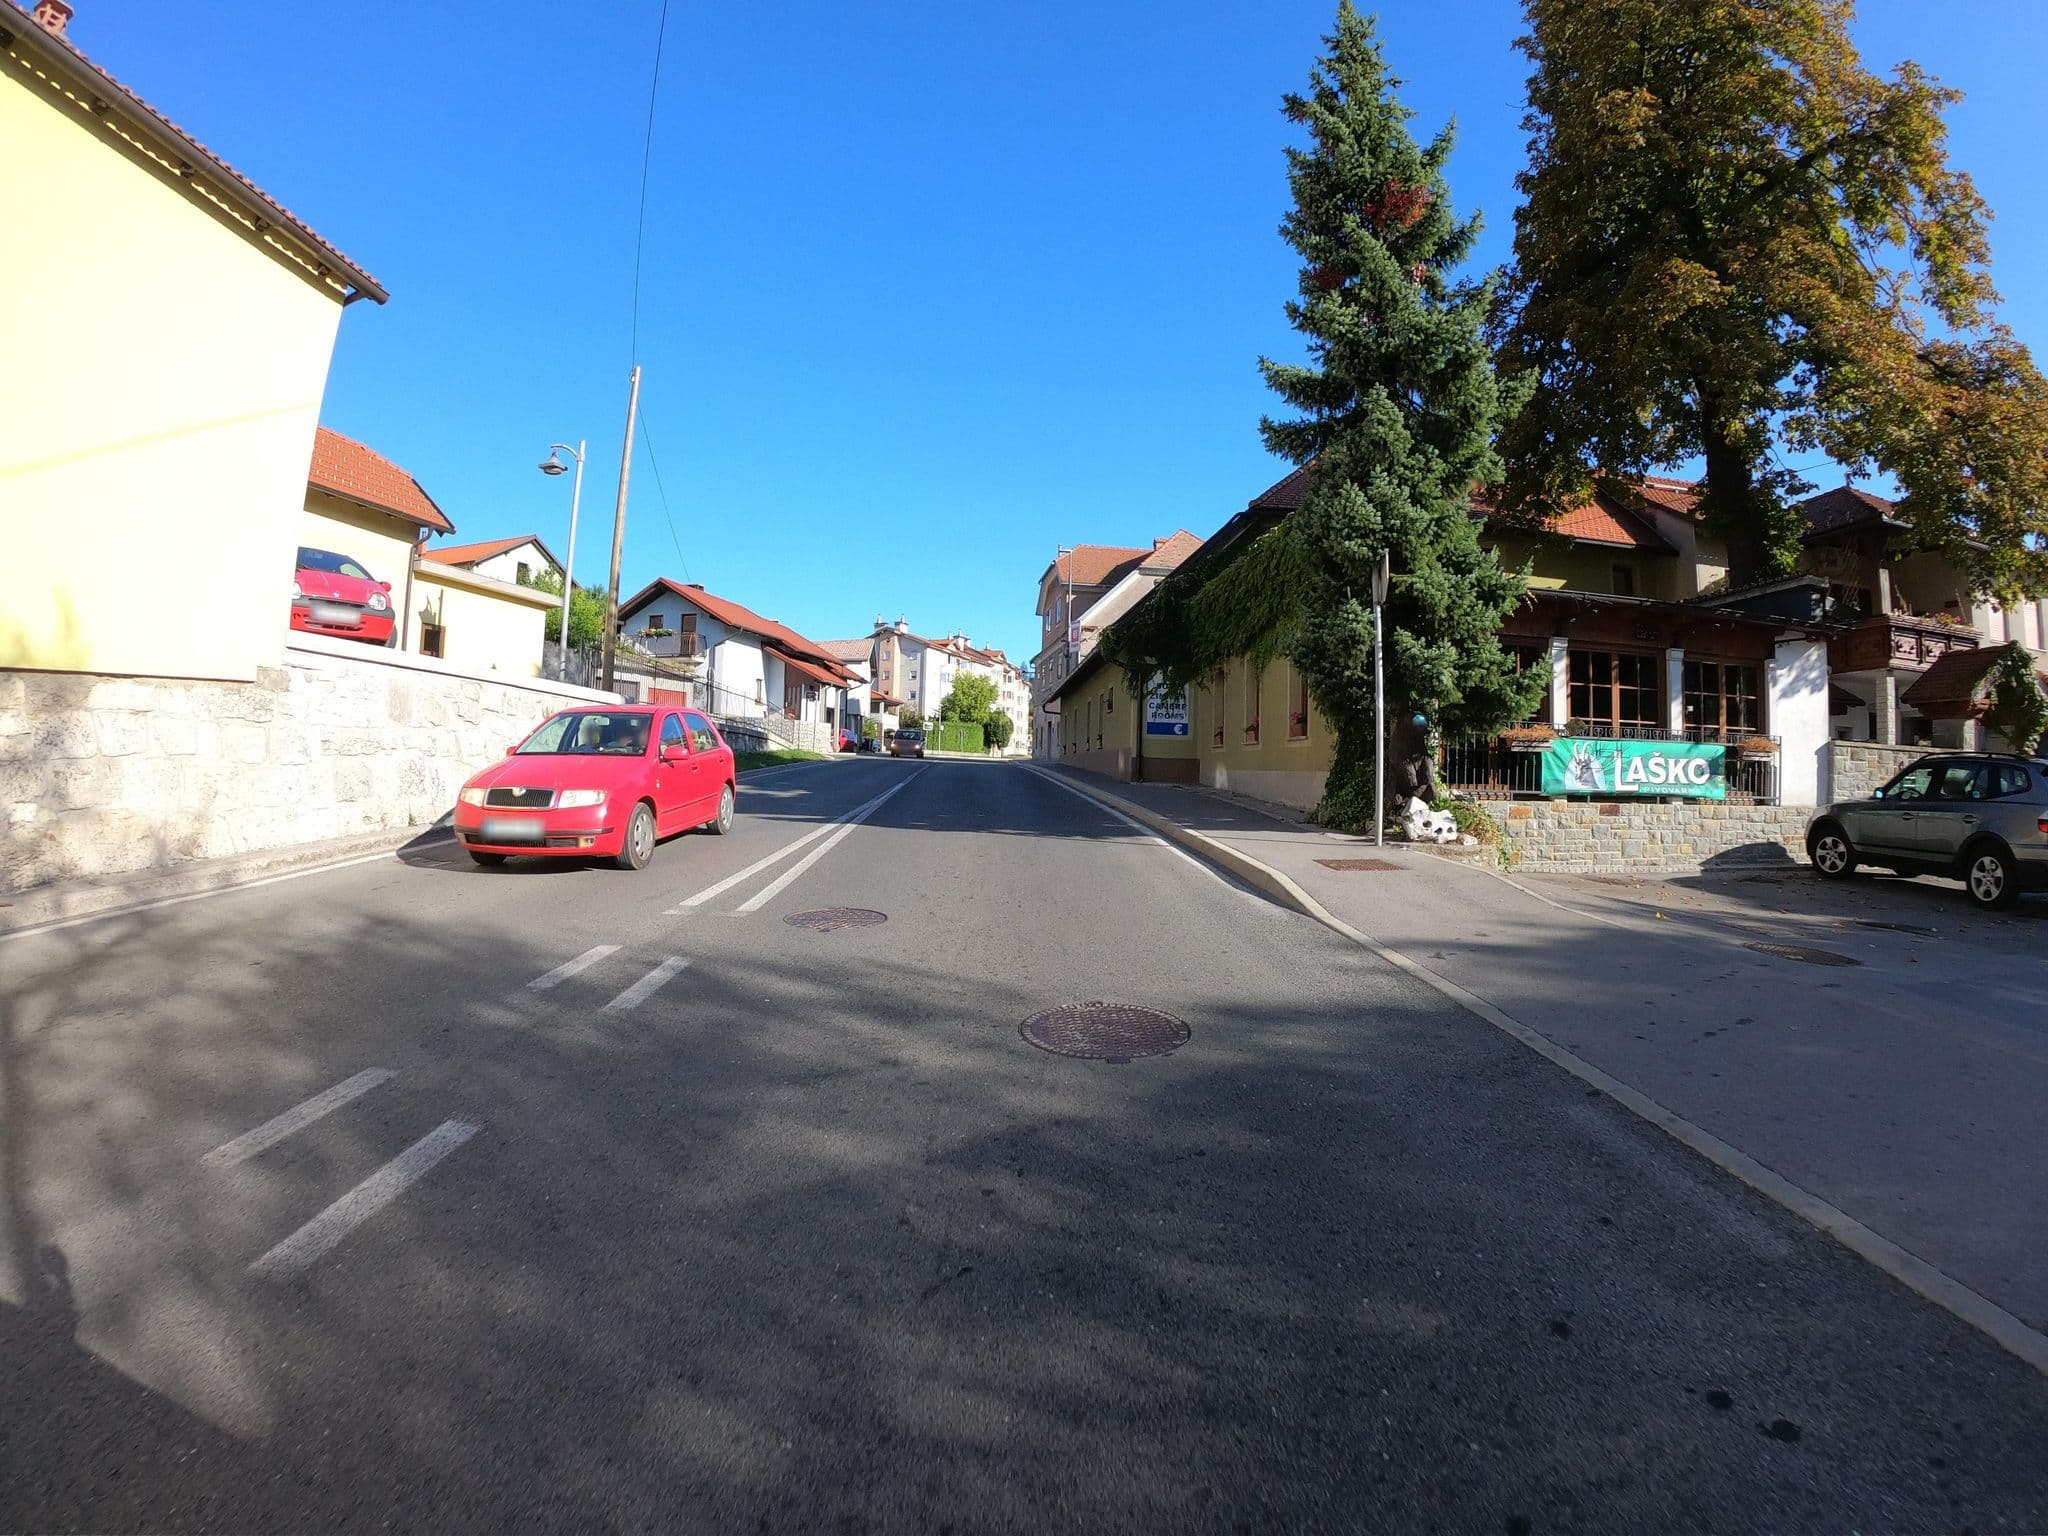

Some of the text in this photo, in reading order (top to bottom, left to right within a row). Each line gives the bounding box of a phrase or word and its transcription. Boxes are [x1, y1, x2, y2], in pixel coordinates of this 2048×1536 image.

[1151, 712, 1185, 720] ROOMS
[1613, 751, 1711, 791] LAŠKO
[1645, 786, 1700, 794] PIVOVARN
